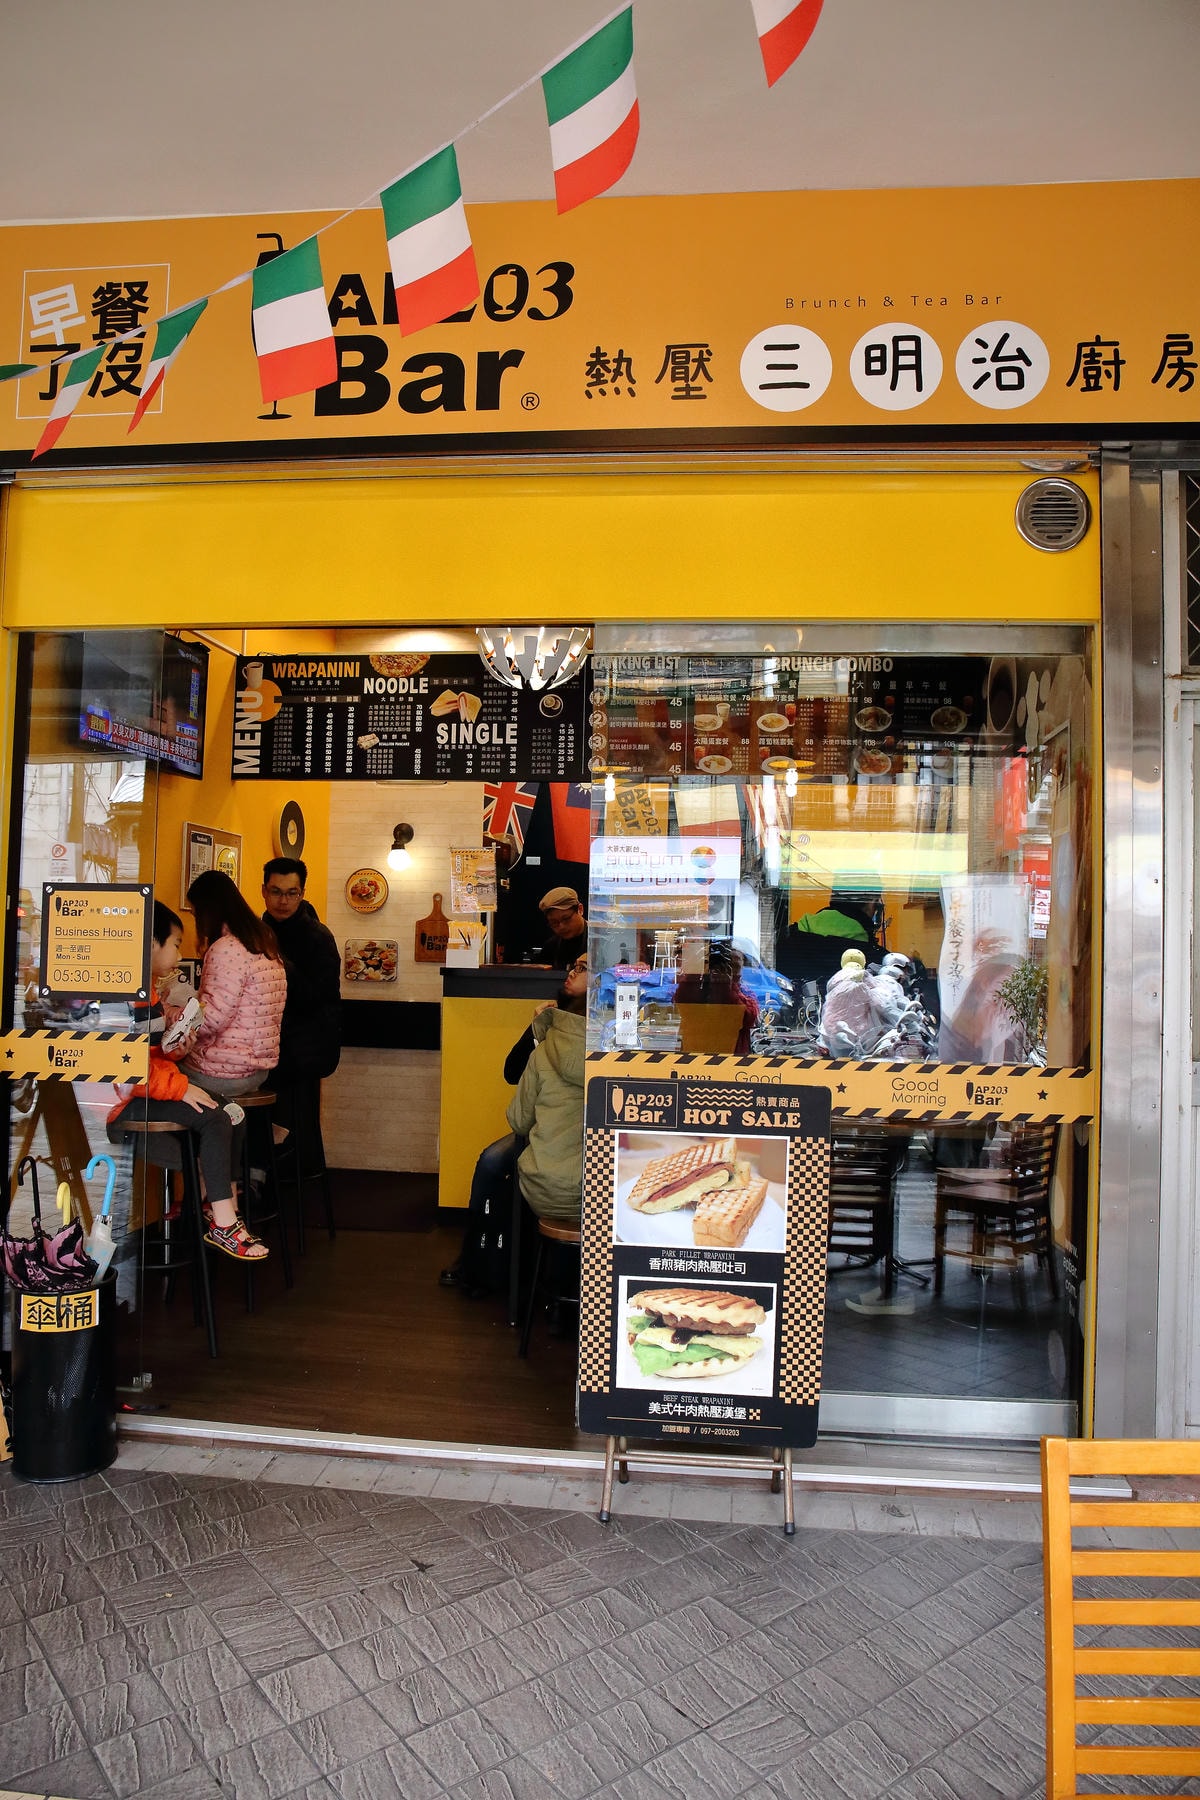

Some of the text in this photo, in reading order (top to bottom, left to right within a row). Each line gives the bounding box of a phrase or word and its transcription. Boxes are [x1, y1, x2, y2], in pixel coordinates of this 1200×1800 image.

[332, 261, 575, 327] A03
[785, 294, 1004, 309] Brunch & Tea Bar
[29, 281, 150, 345] 早餐
[314, 335, 524, 417] Bar
[272, 662, 360, 678] WRAPANINI
[654, 656, 681, 670] LIST
[774, 656, 894, 672] BRUNCH COMBO
[363, 677, 429, 694] NOODLE
[670, 698, 682, 706] 45
[670, 720, 682, 729] 55
[233, 690, 264, 774] MENU
[436, 723, 518, 744] SINGLE
[669, 742, 682, 751] 45
[669, 765, 681, 773] 45
[616, 789, 641, 830] Bar
[634, 788, 661, 836] AP203
[62, 907, 83, 916] Bar
[56, 927, 133, 938] Business Hours
[56, 945, 91, 953] 週一至週日
[54, 969, 132, 983] 05:30-13:30
[55, 1057, 78, 1067] Bar
[735, 1071, 782, 1084] Good
[892, 1077, 939, 1092] Good
[976, 1085, 1008, 1096] AP203
[626, 1094, 673, 1107] AP203
[756, 1096, 800, 1108] 熱賣商品
[892, 1092, 947, 1106] Morning
[974, 1095, 1002, 1105] Bar
[624, 1106, 664, 1123] Bar
[683, 1109, 801, 1128] HOT SALE
[679, 1251, 700, 1259] FILLET
[703, 1252, 735, 1260] WRAPANINI
[649, 1258, 746, 1274] 香煎豬肉熱壓吐司
[27, 1295, 92, 1330] 傘桶
[664, 1395, 734, 1405] BEEF STEAK WRAPANINI
[648, 1402, 746, 1420] 美式牛肉熱壓漢堡
[662, 1425, 690, 1434] 加盟專線
[700, 1427, 740, 1436] 097-2003203
